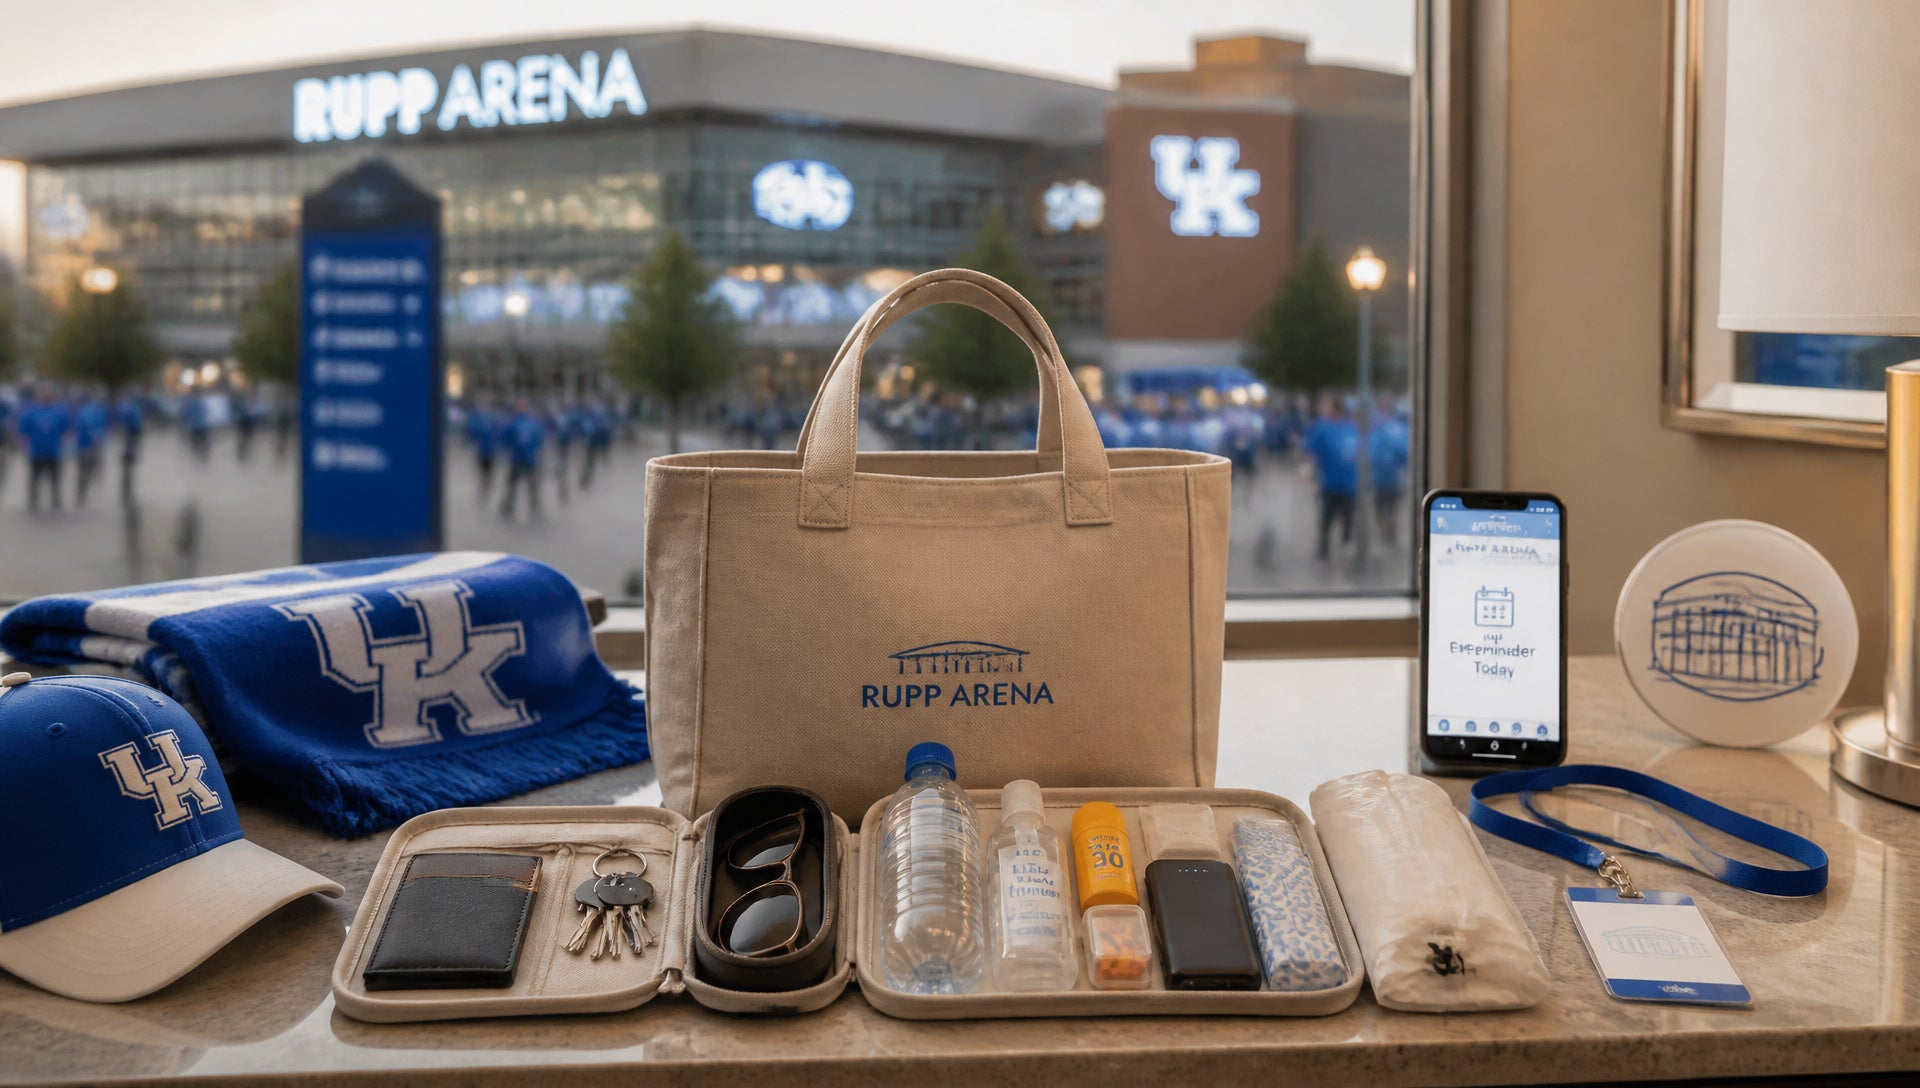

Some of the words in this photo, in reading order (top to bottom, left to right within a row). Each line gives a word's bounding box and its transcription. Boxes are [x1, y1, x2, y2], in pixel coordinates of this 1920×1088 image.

[293, 67, 439, 143] RUPP
[437, 48, 648, 131] ARENA
[1150, 135, 1260, 237] UK
[270, 579, 535, 748] UK
[861, 684, 942, 708] RUPP
[950, 682, 1055, 707] ARENA
[1474, 661, 1515, 679] Today
[97, 729, 223, 830] UK
